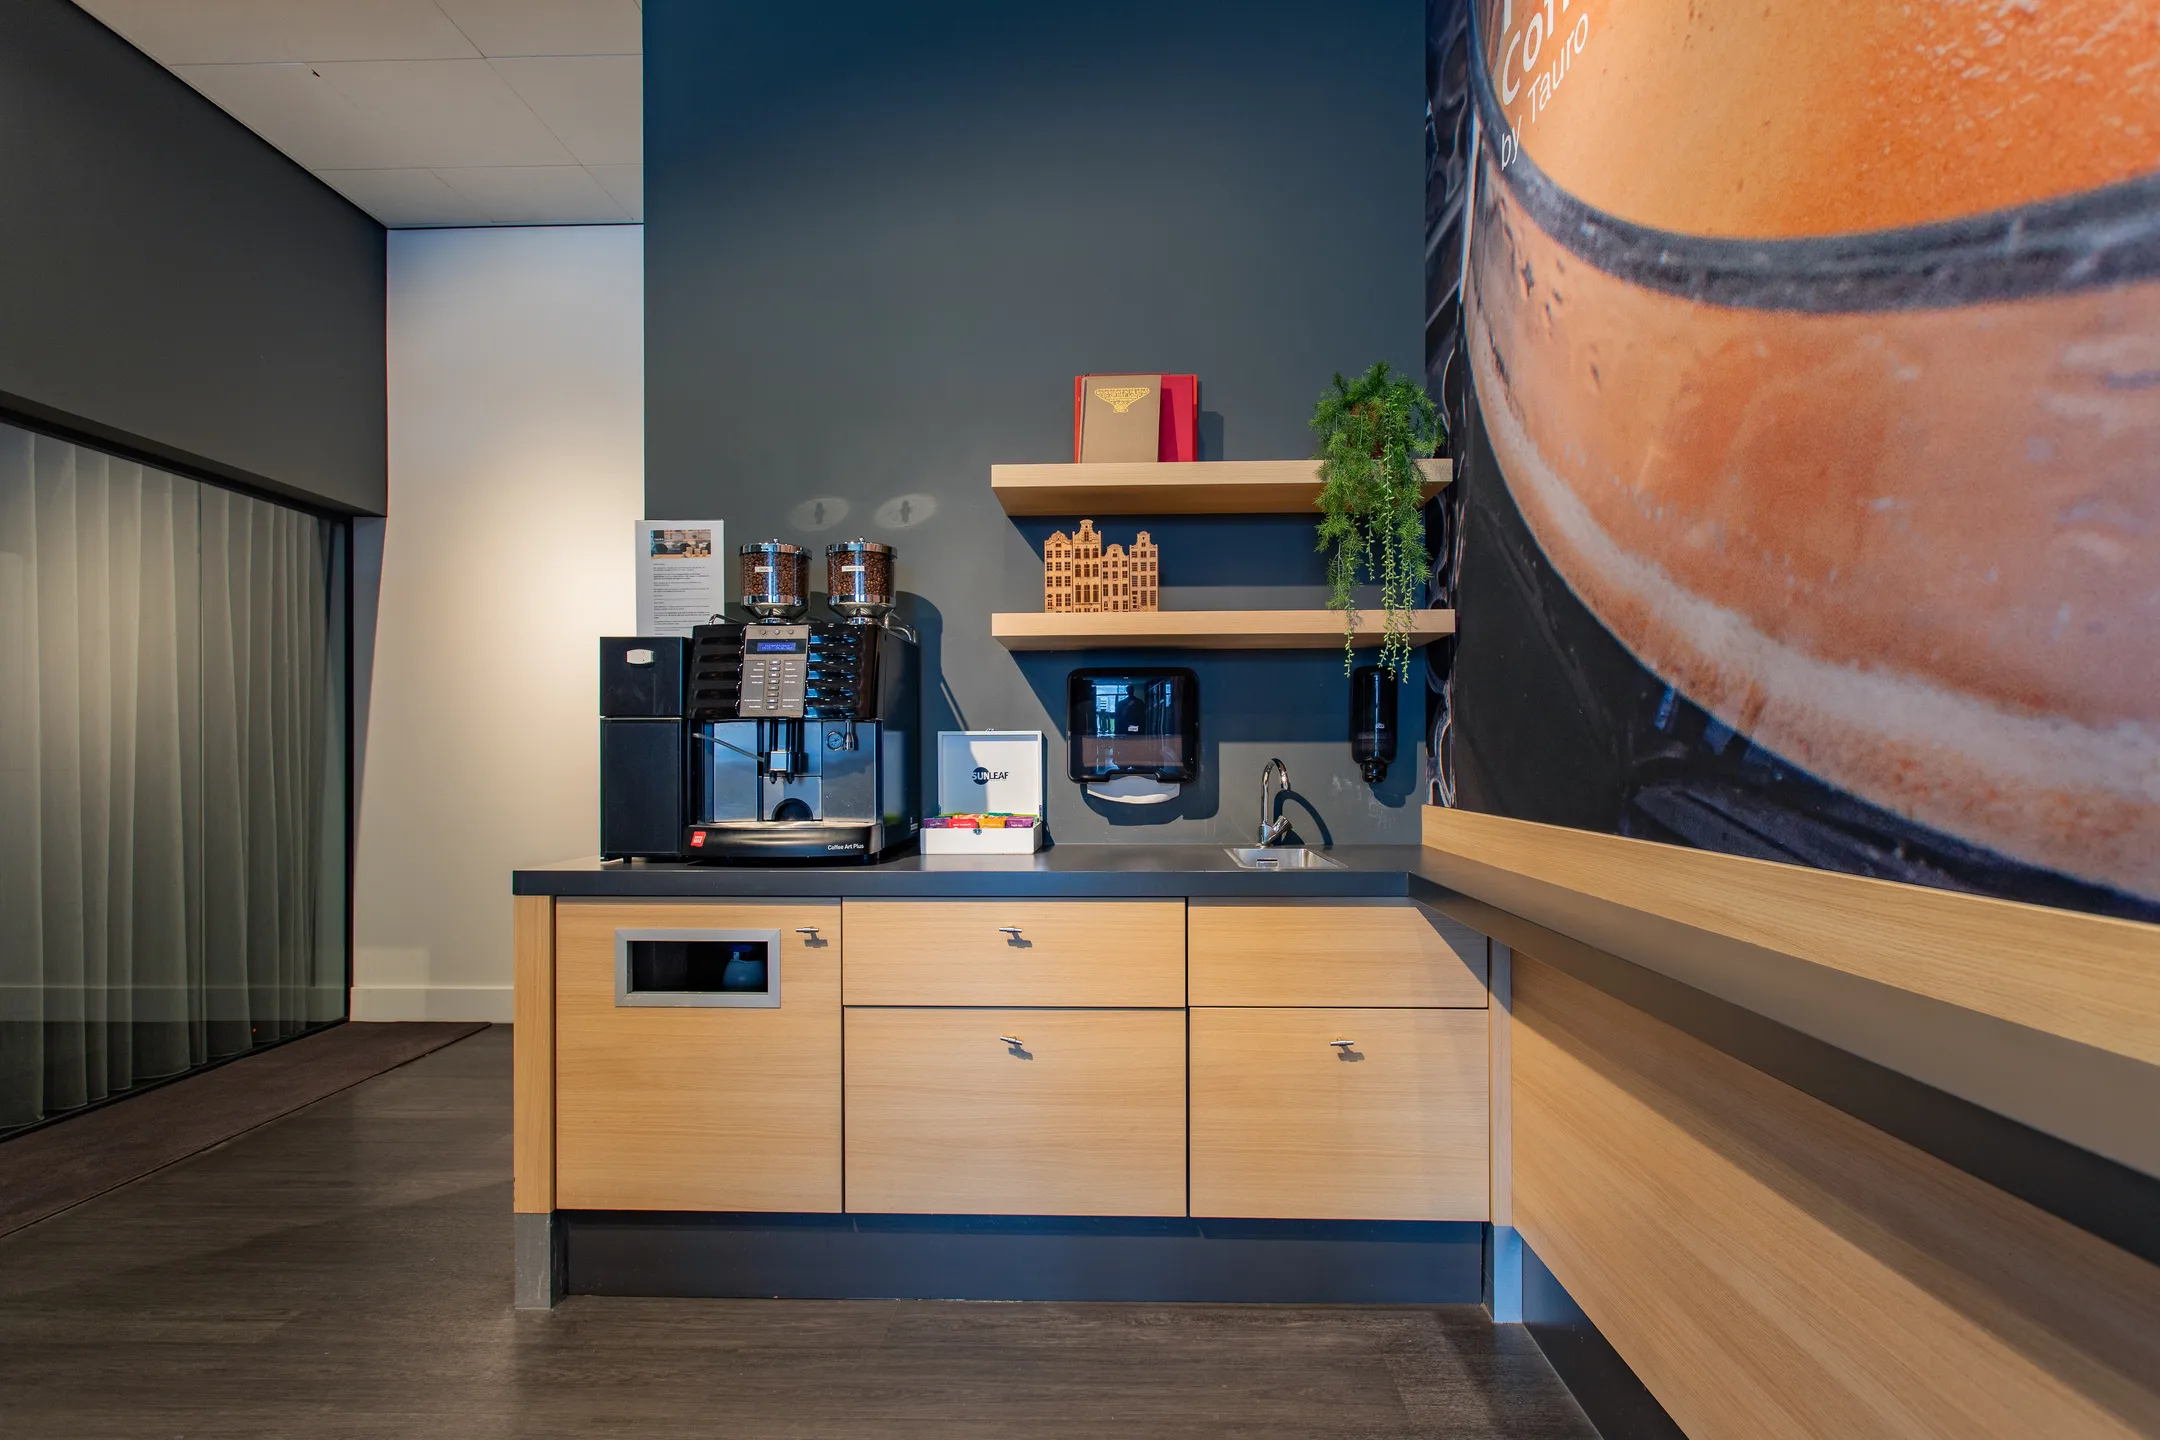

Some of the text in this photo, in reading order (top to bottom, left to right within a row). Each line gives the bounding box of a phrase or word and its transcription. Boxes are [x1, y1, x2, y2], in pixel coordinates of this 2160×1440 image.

[1501, 13, 1589, 171] by Tauro
[971, 771, 1009, 780] SUNLEAF
